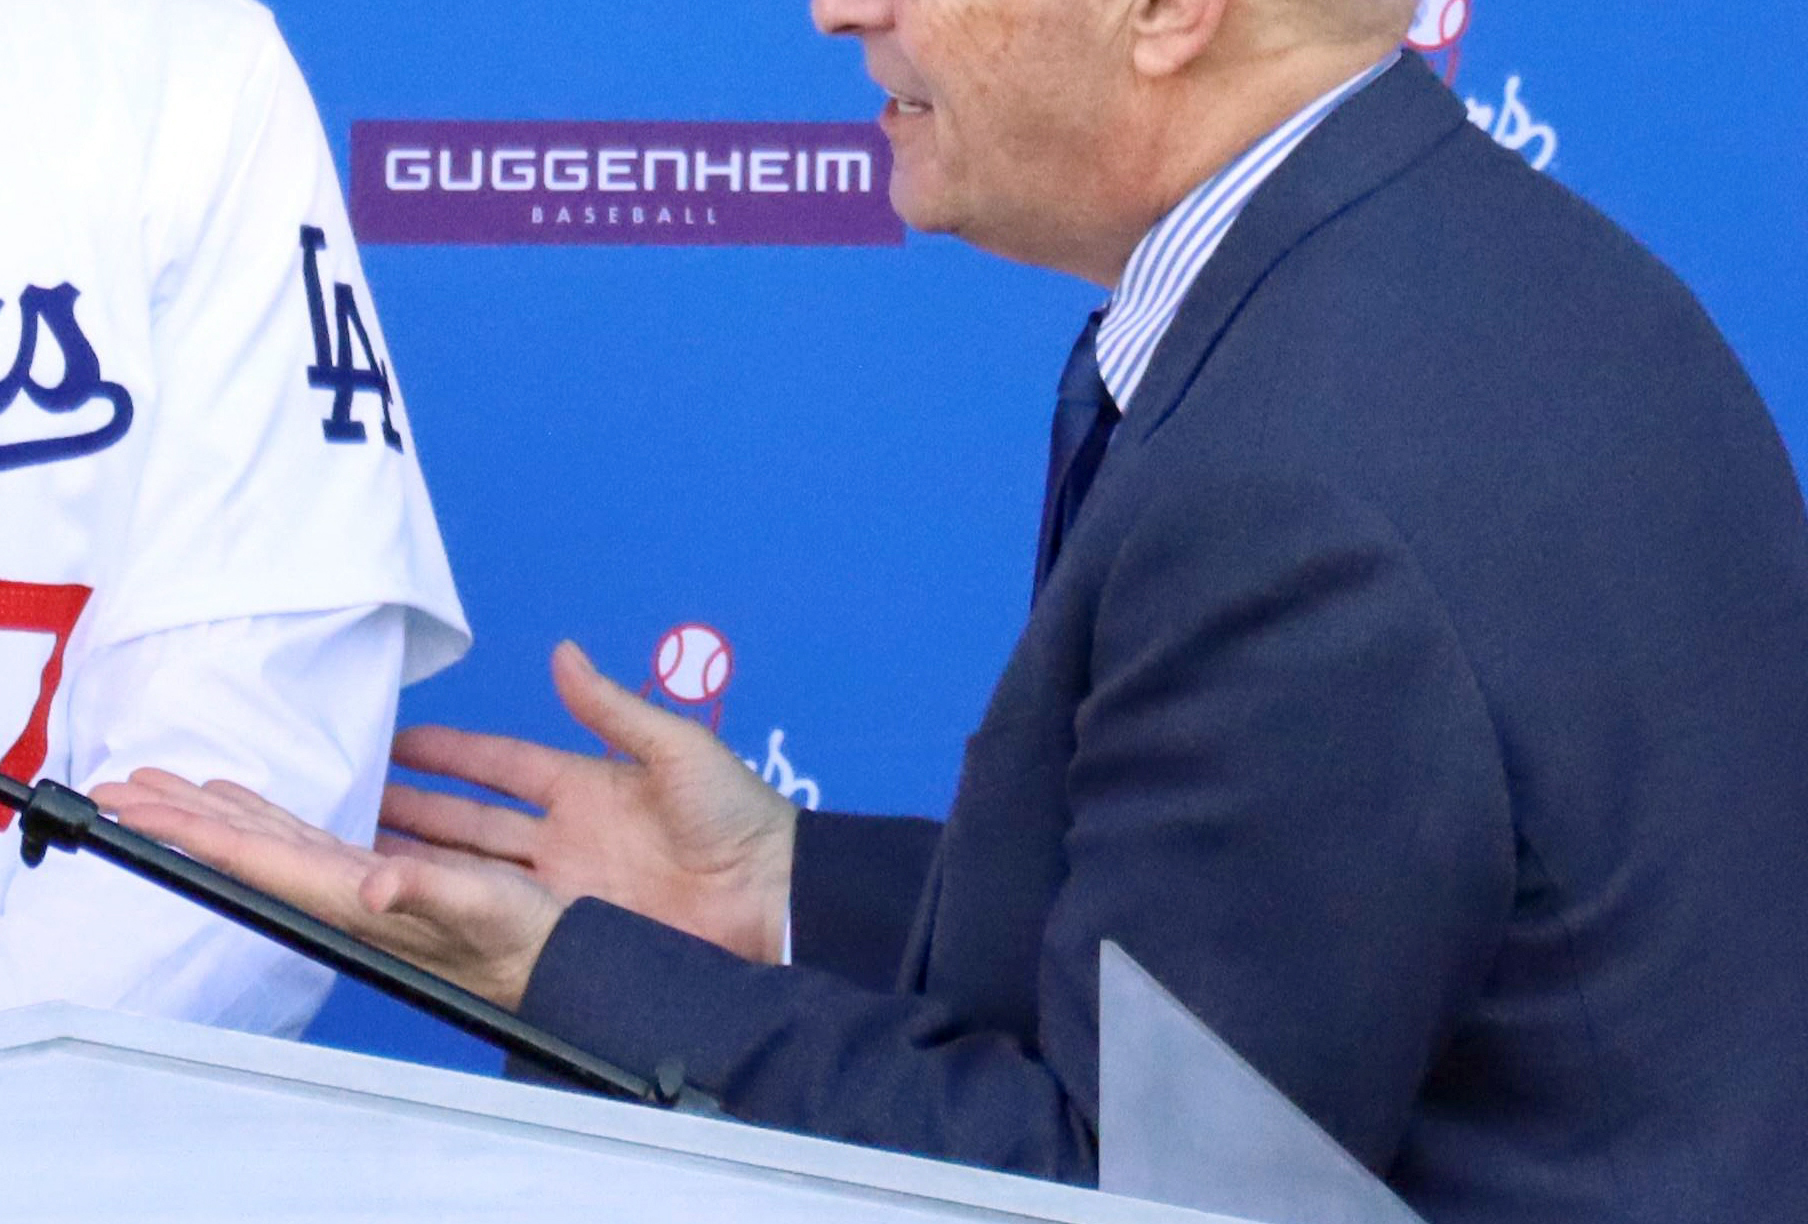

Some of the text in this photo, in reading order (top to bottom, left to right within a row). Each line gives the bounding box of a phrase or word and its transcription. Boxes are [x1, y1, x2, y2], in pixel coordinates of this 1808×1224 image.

[385, 148, 872, 193] GUGGENHEIM
[531, 206, 718, 224] BASEBALL
[299, 225, 403, 452] LA
